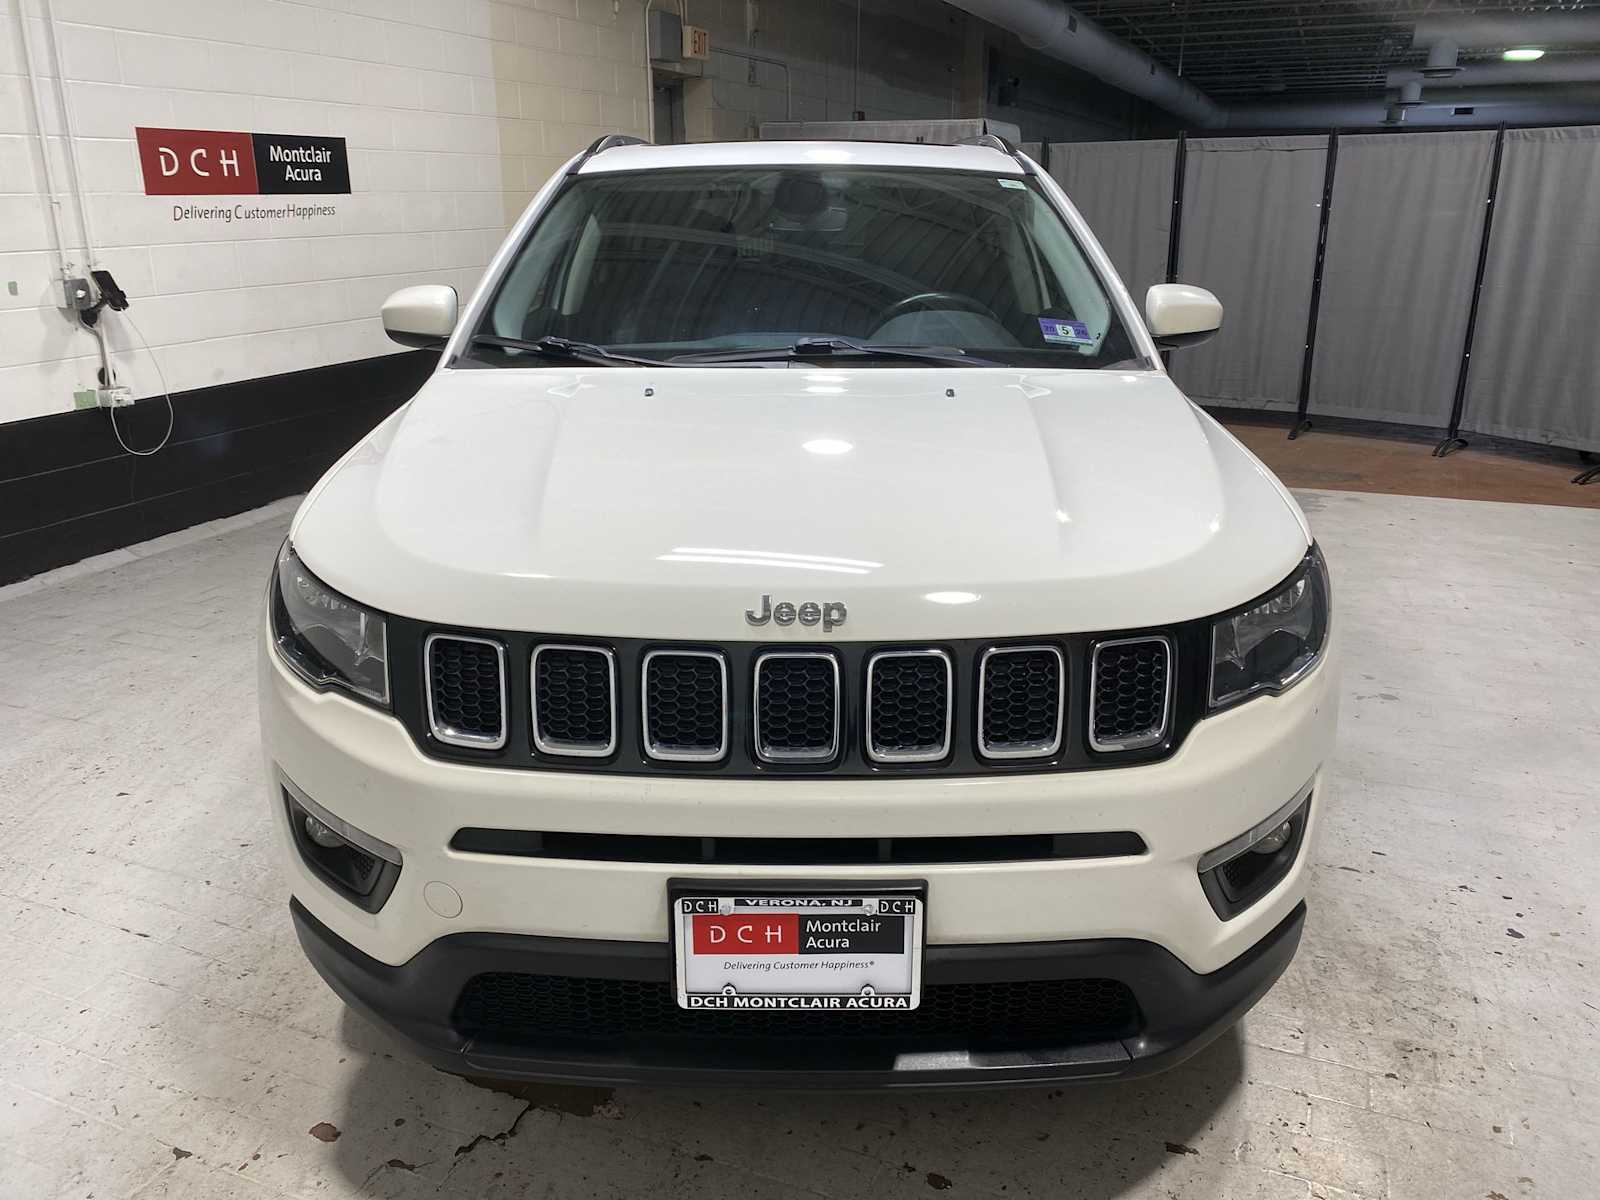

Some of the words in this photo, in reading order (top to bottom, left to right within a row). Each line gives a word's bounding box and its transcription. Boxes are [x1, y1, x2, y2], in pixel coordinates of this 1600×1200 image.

[269, 145, 332, 163] Montclair
[158, 147, 240, 177] DCH
[285, 164, 322, 182] Acura
[173, 205, 232, 223] Delivering
[1061, 326, 1070, 336] 5
[745, 594, 847, 633] Jeep
[683, 900, 717, 913] DCH
[831, 898, 853, 907] NJ
[880, 900, 915, 913] DCH
[805, 918, 882, 933] Montclair
[710, 925, 782, 944] DCH
[805, 935, 850, 949] Acura
[723, 960, 771, 972] Delivering
[773, 960, 819, 971] Customer
[690, 997, 729, 1008] DCH
[733, 997, 841, 1009] MONTCLAIR
[845, 997, 908, 1009] ACURA
